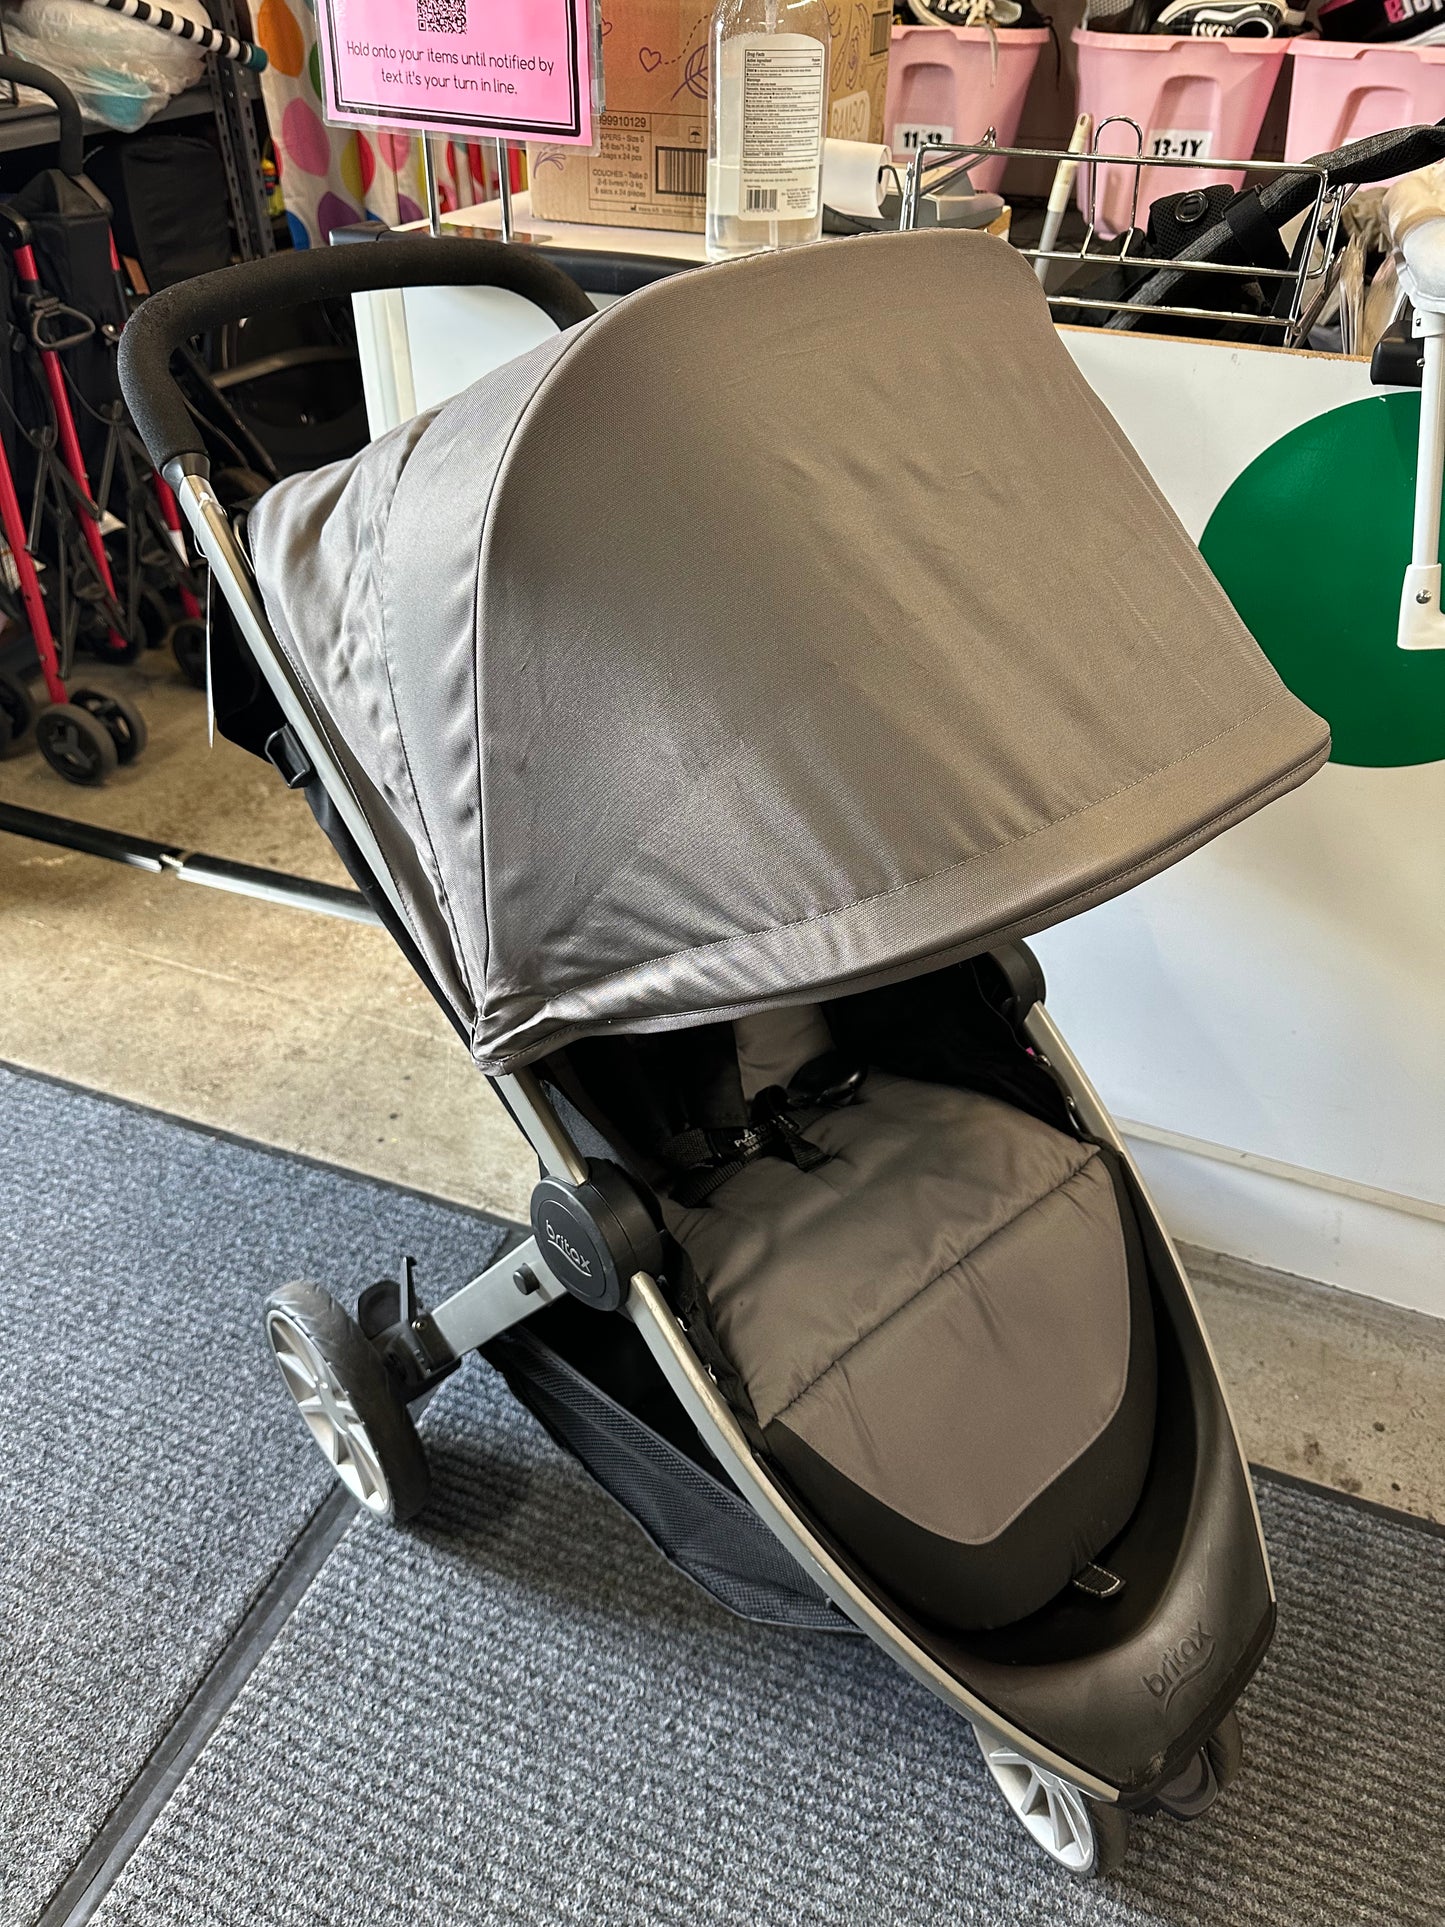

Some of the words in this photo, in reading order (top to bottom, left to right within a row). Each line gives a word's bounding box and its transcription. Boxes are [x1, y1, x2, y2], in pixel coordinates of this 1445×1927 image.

[346, 40, 370, 57] Hold
[372, 44, 397, 59] onto
[399, 49, 424, 63] your
[427, 48, 459, 64] items
[461, 51, 487, 67] until
[489, 53, 536, 71] notified
[538, 56, 555, 76] by
[381, 67, 404, 84] text
[405, 70, 422, 86] it's
[424, 75, 450, 90] your
[453, 74, 479, 90] turn
[480, 78, 492, 92] in
[493, 78, 518, 95] line.
[600, 133, 621, 142] APERS
[1153, 138, 1203, 157] 13-1Y
[545, 1219, 592, 1274] britax
[1141, 1620, 1214, 1698] britax
